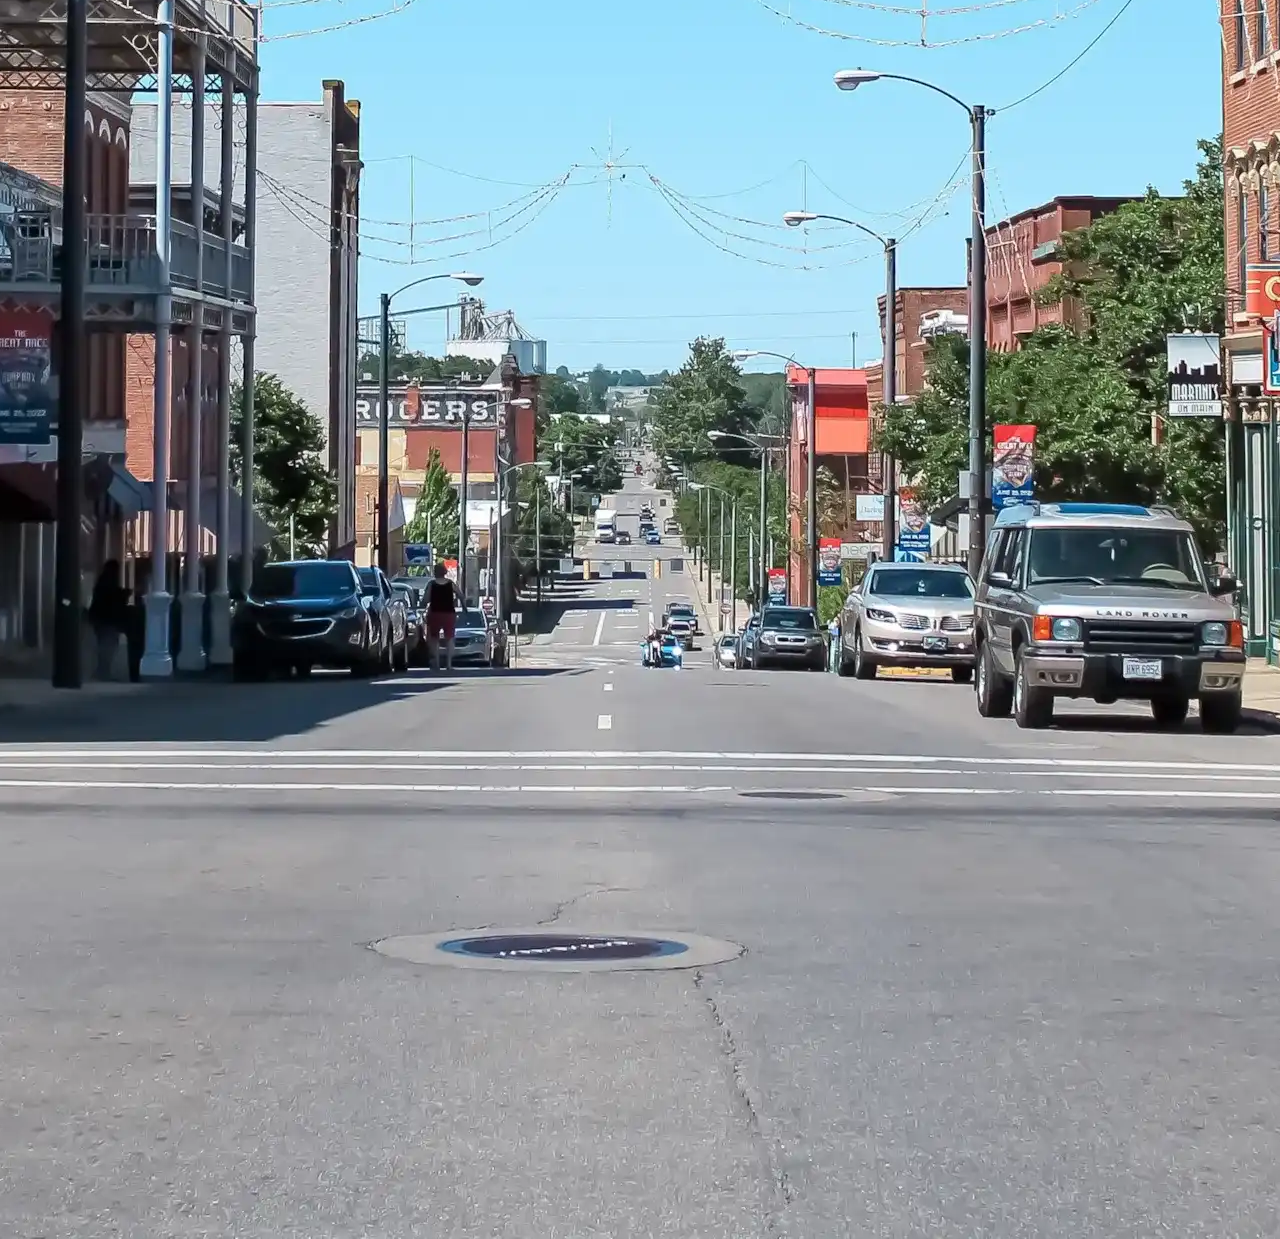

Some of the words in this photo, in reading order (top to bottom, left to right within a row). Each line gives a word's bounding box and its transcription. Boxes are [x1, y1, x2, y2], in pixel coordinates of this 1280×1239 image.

[1171, 383, 1219, 401] MARTINI'S
[1191, 404, 1214, 413] MAIN
[1142, 611, 1189, 619] ROVER
